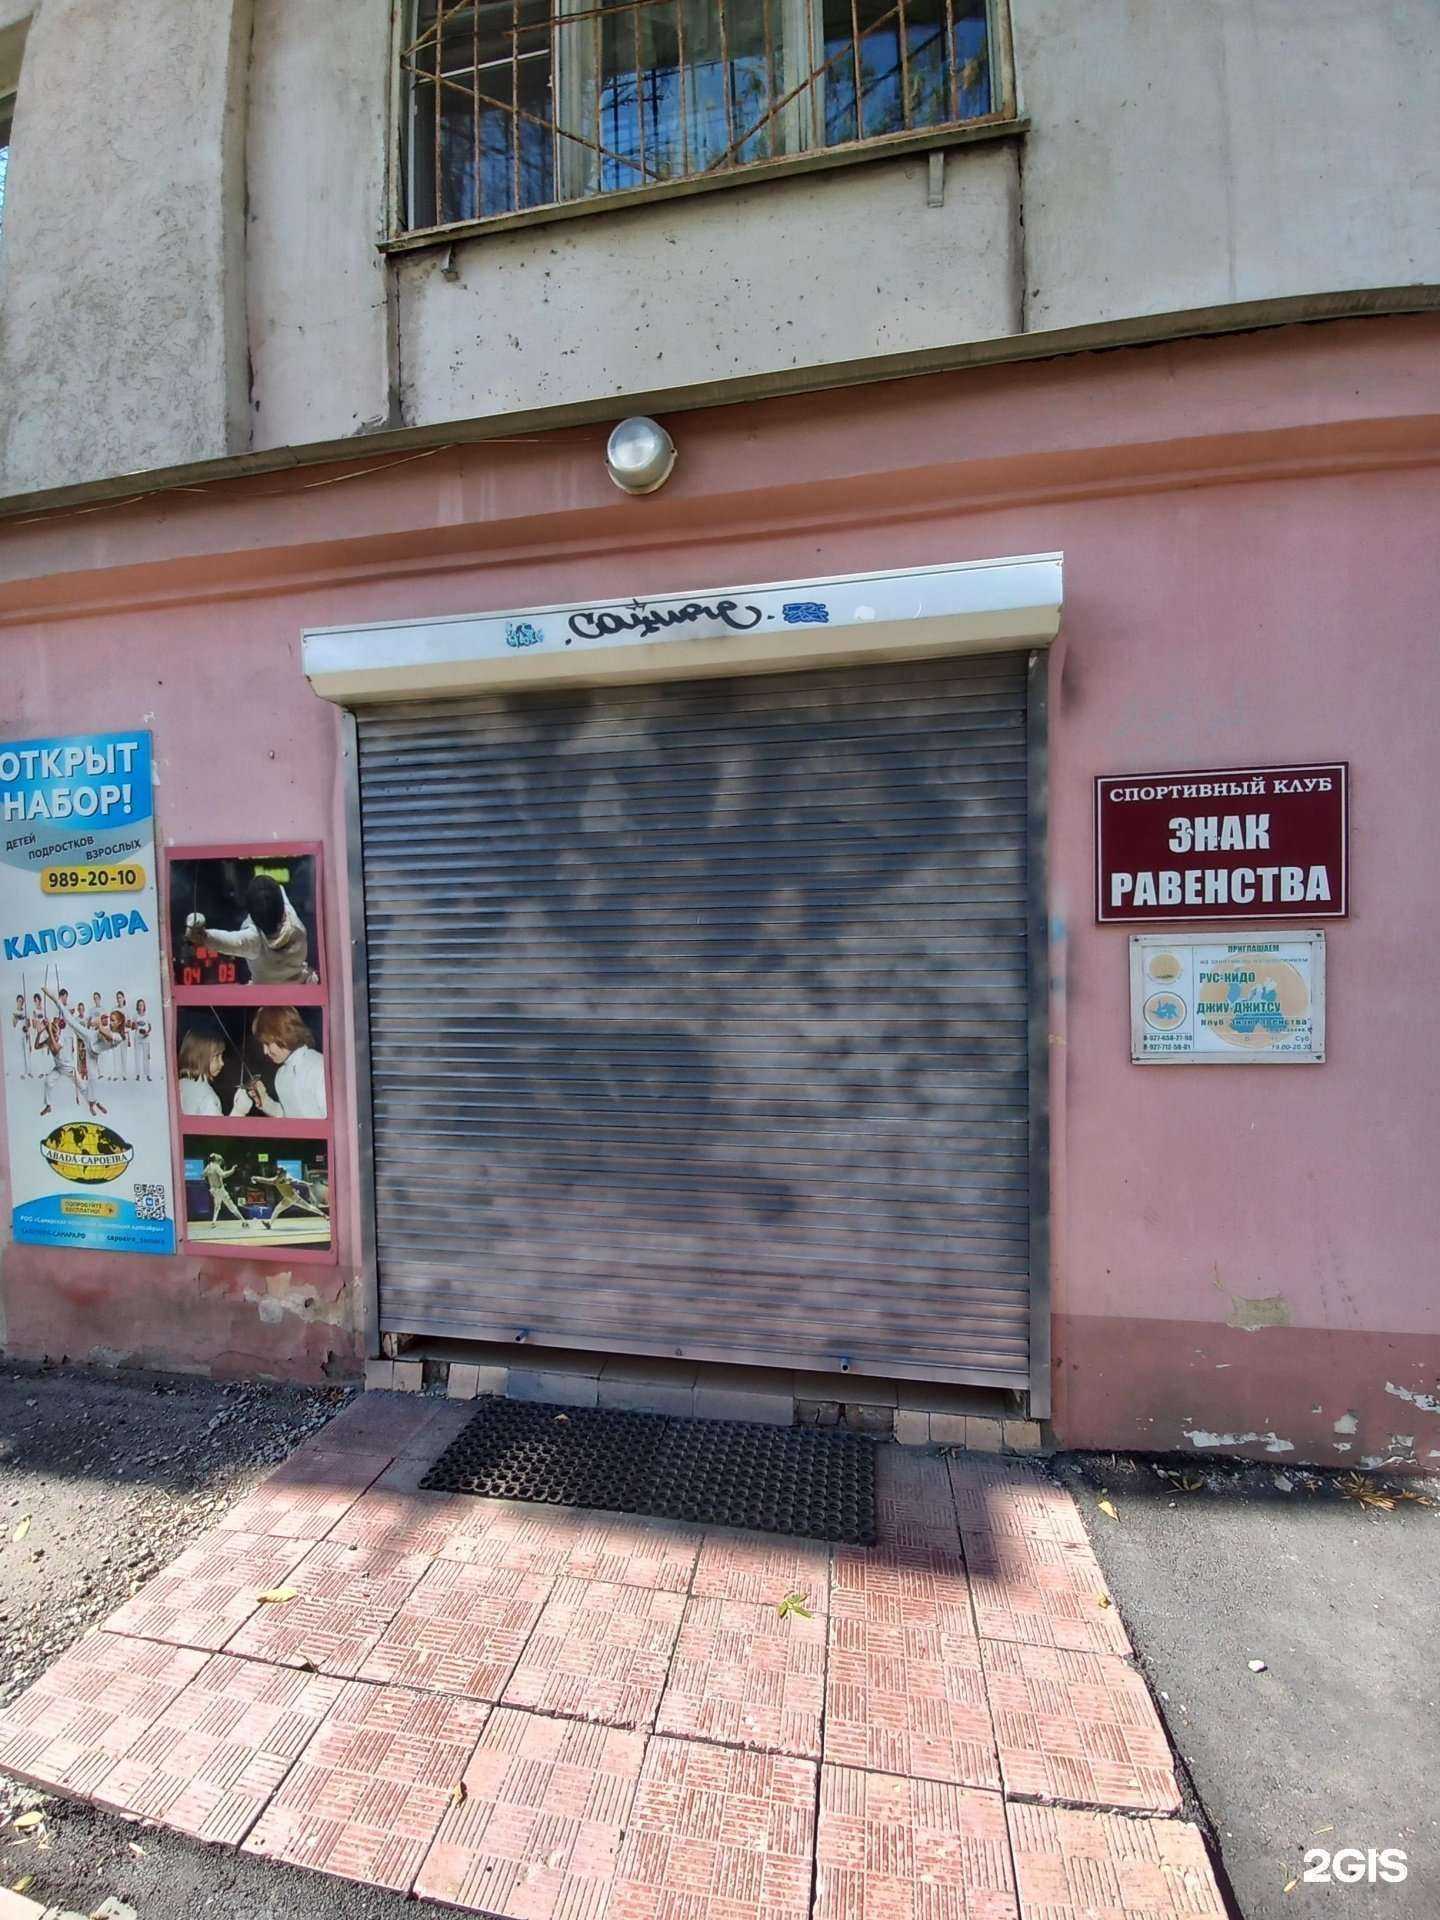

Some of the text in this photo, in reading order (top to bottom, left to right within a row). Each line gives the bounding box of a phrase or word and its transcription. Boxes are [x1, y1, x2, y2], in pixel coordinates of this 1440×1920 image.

[0, 741, 138, 782] ОТКРЫТ
[4, 784, 132, 821] НАБОР!
[1109, 776, 1333, 802] СПОРТИВНЫЙ КЛУБ
[6, 833, 37, 851] ДЕТЕЙ
[28, 835, 95, 860] ПОДРОСТКОВ
[1168, 814, 1271, 853] ЗНАК
[85, 839, 142, 861] ВЗРОСЛЫХ
[48, 869, 137, 888] 989-20-10
[1111, 865, 1332, 907] РАВЕНСТВА
[3, 909, 149, 961] КАПОЭЙРА
